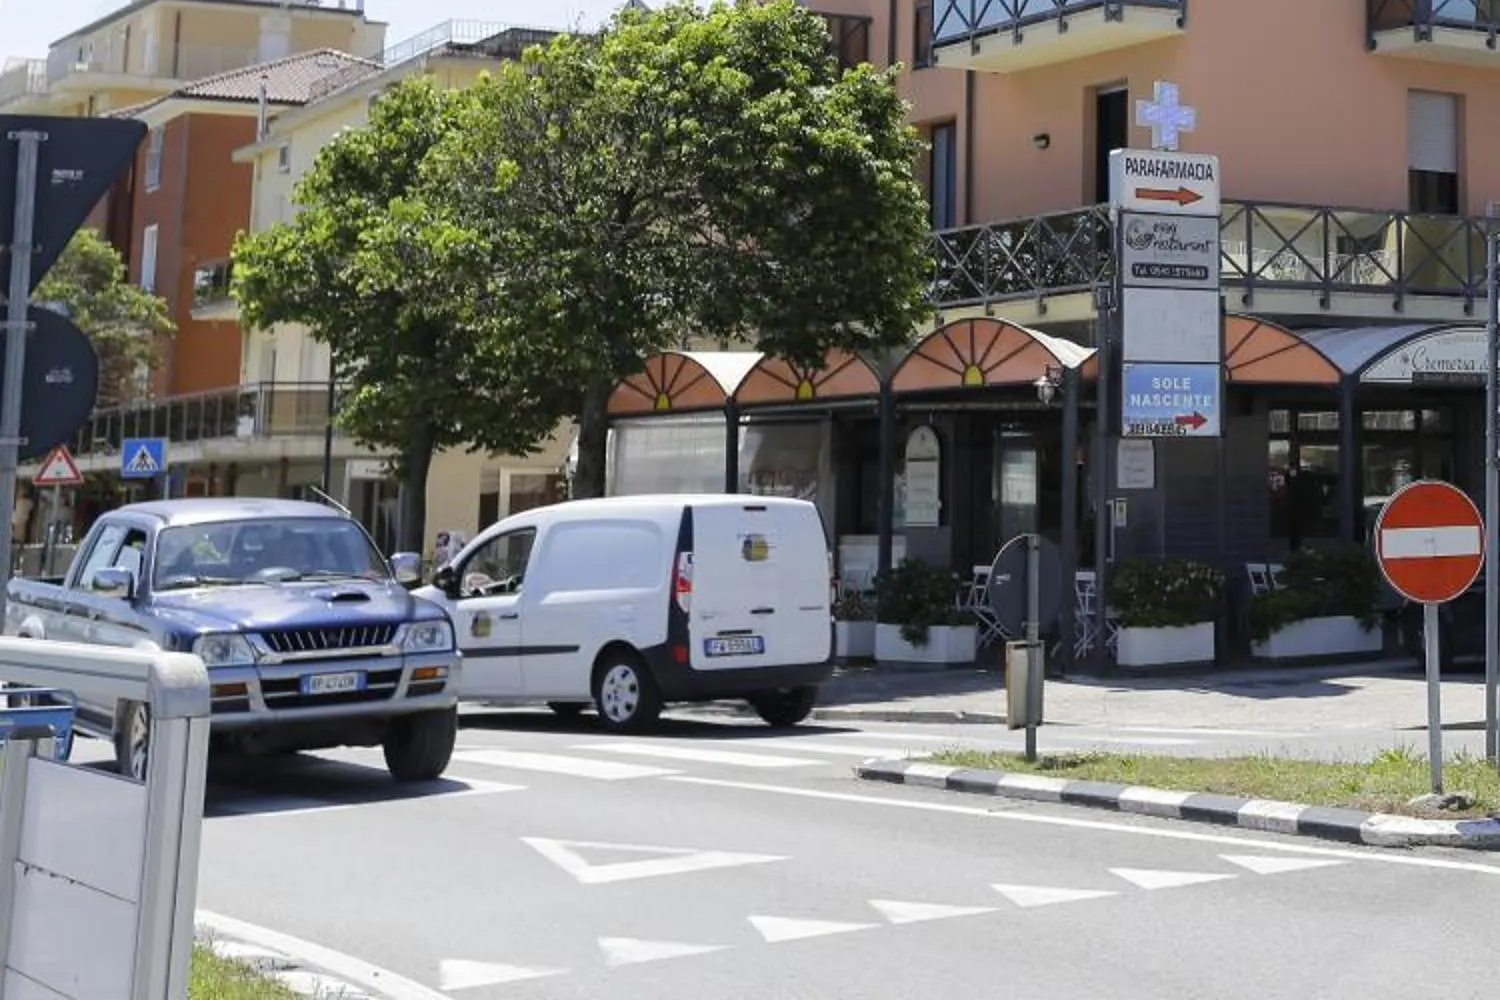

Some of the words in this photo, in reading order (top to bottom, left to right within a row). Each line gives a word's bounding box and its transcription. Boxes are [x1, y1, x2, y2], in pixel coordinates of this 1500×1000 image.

[1125, 157, 1214, 181] PARAFARMACIA
[1152, 377, 1191, 389] SOLE
[1131, 392, 1212, 408] NASCENTE
